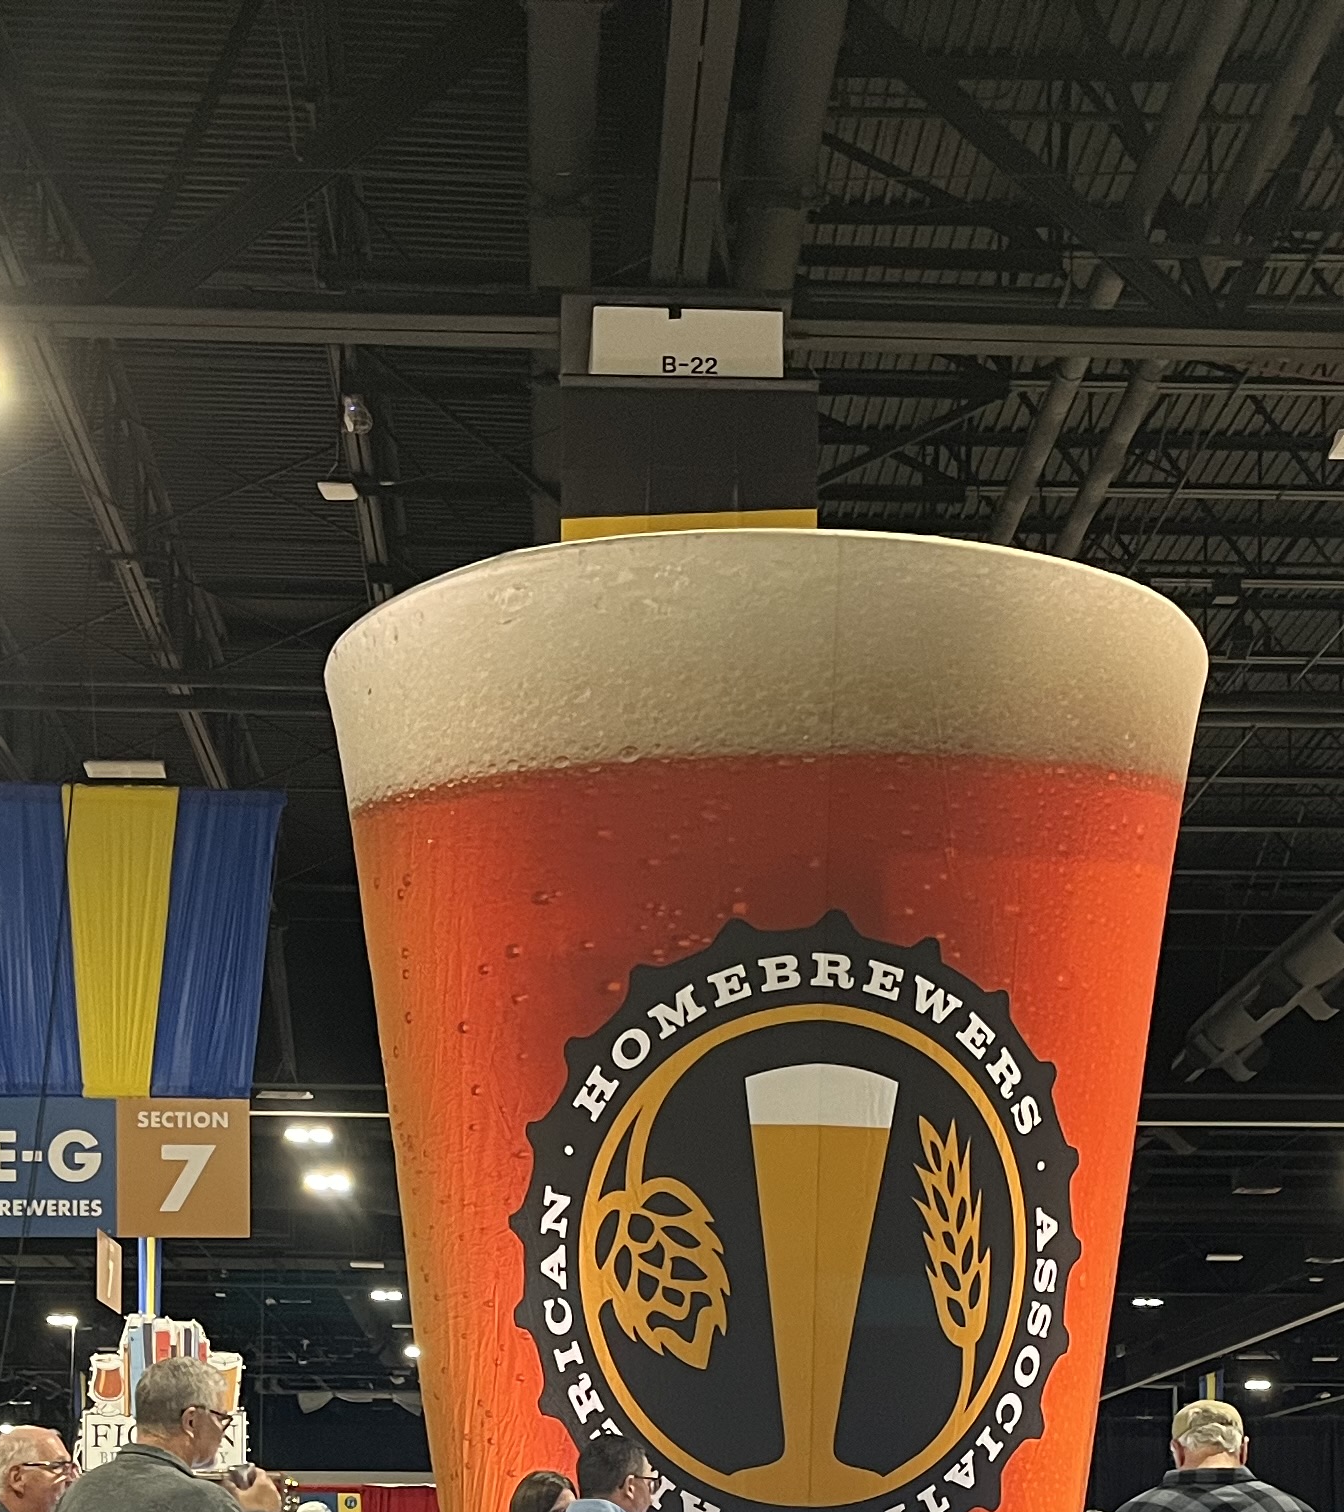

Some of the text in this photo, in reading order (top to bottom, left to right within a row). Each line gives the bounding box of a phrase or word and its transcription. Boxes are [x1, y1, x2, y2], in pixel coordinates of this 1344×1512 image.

[662, 356, 718, 375] B-22
[573, 951, 1042, 1135] HOMEBREWERS
[137, 1111, 229, 1128] SECTION
[159, 1144, 216, 1212] 7
